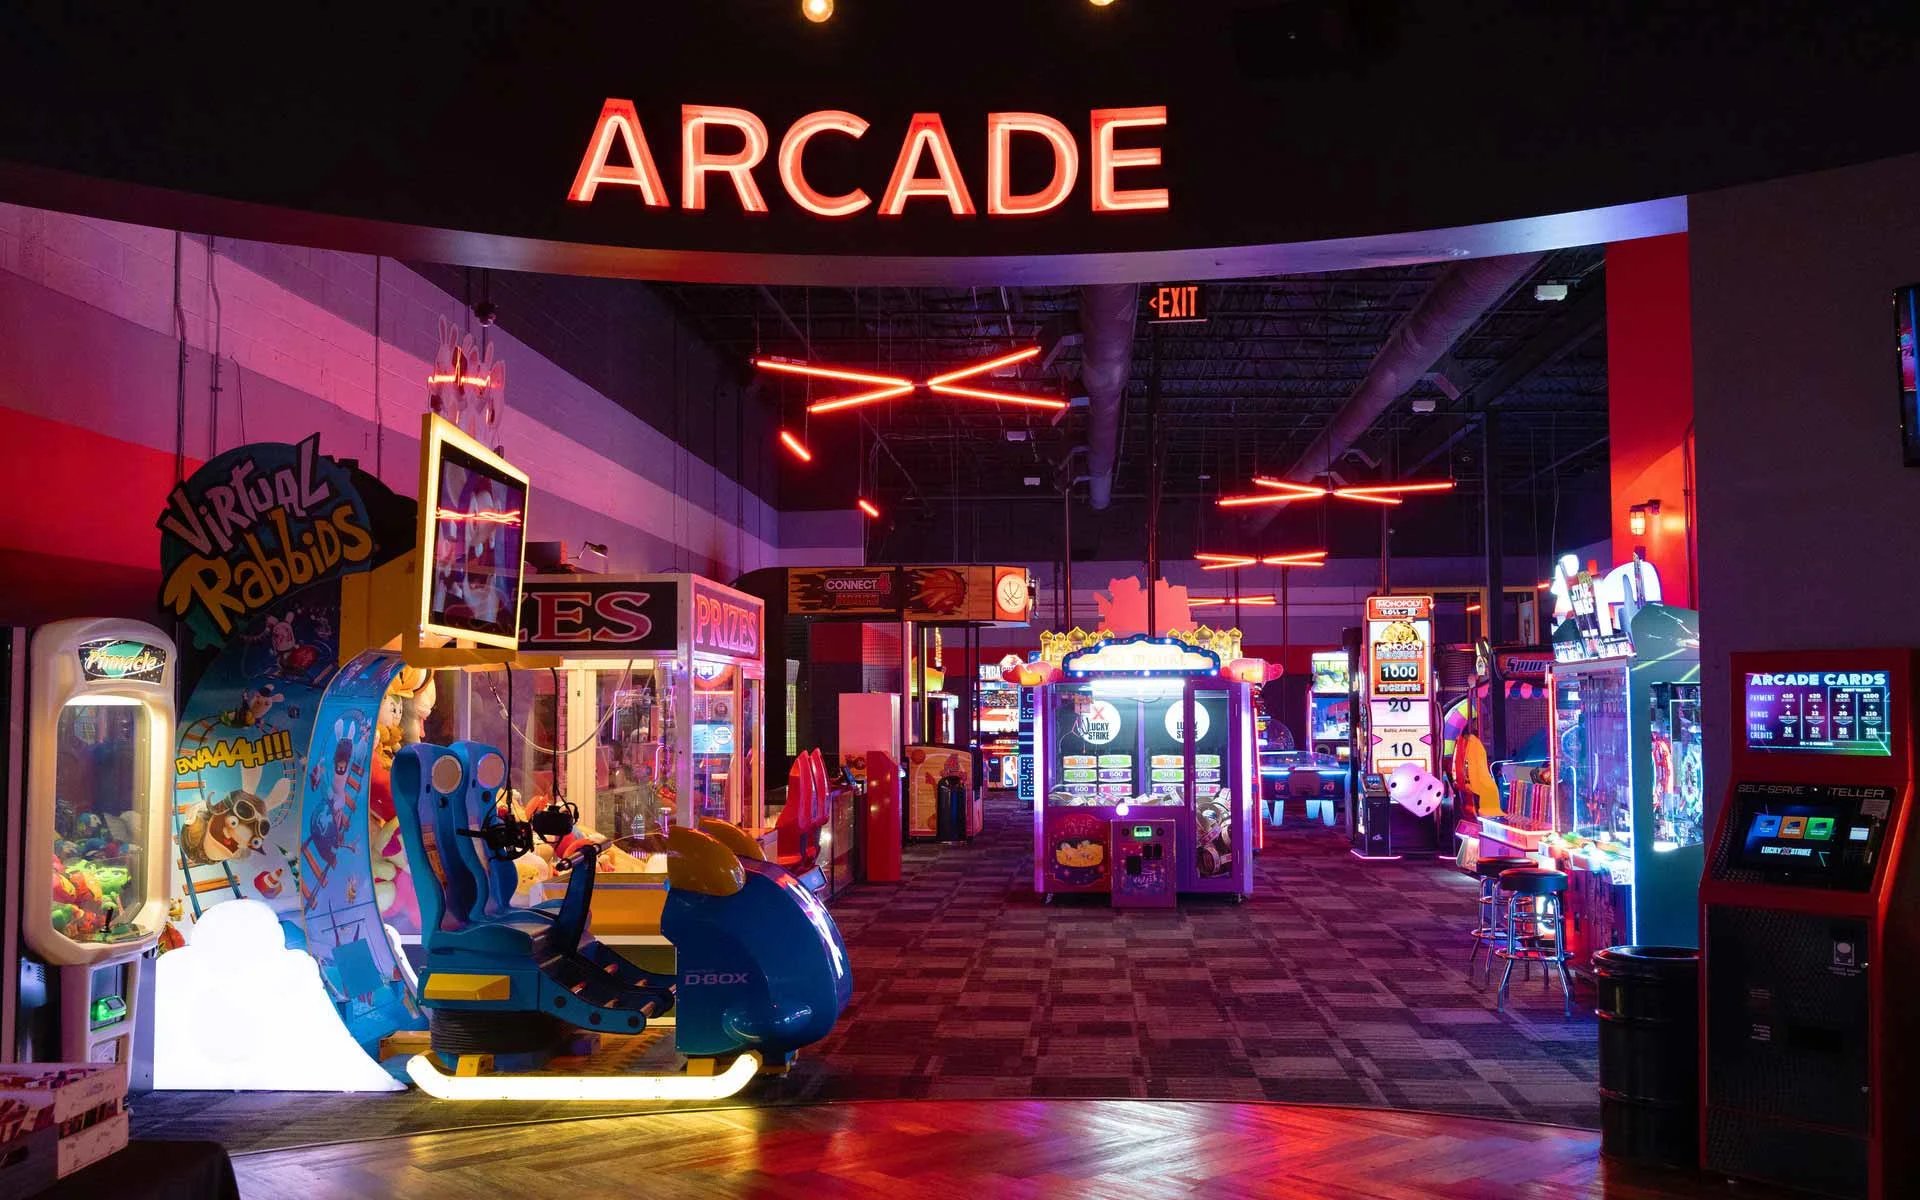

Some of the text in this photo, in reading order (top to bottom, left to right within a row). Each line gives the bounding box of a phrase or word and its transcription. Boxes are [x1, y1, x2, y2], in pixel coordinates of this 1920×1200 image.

[568, 98, 1170, 217] ARCADE
[1158, 286, 1199, 318] EXIT
[826, 579, 878, 591] CONNECT
[1376, 600, 1422, 609] MONOPOLY
[696, 593, 757, 655] PRIZES
[1376, 643, 1423, 652] MONOPOLY
[87, 648, 157, 671] Pinnacle
[985, 664, 1001, 680] NBA
[1382, 666, 1417, 678] 1000
[1750, 673, 1886, 686] ARCADE CARDS
[1750, 694, 1775, 702] PAYMENT
[1388, 697, 1411, 713] 20
[1088, 722, 1109, 731] LUCKY
[1088, 731, 1109, 740] STRIKE
[1391, 742, 1413, 757] 10
[1737, 784, 1806, 795] SELF-SERVE
[1760, 846, 1813, 857] LUCKY STRIKE
[684, 972, 748, 986] D-BOX
